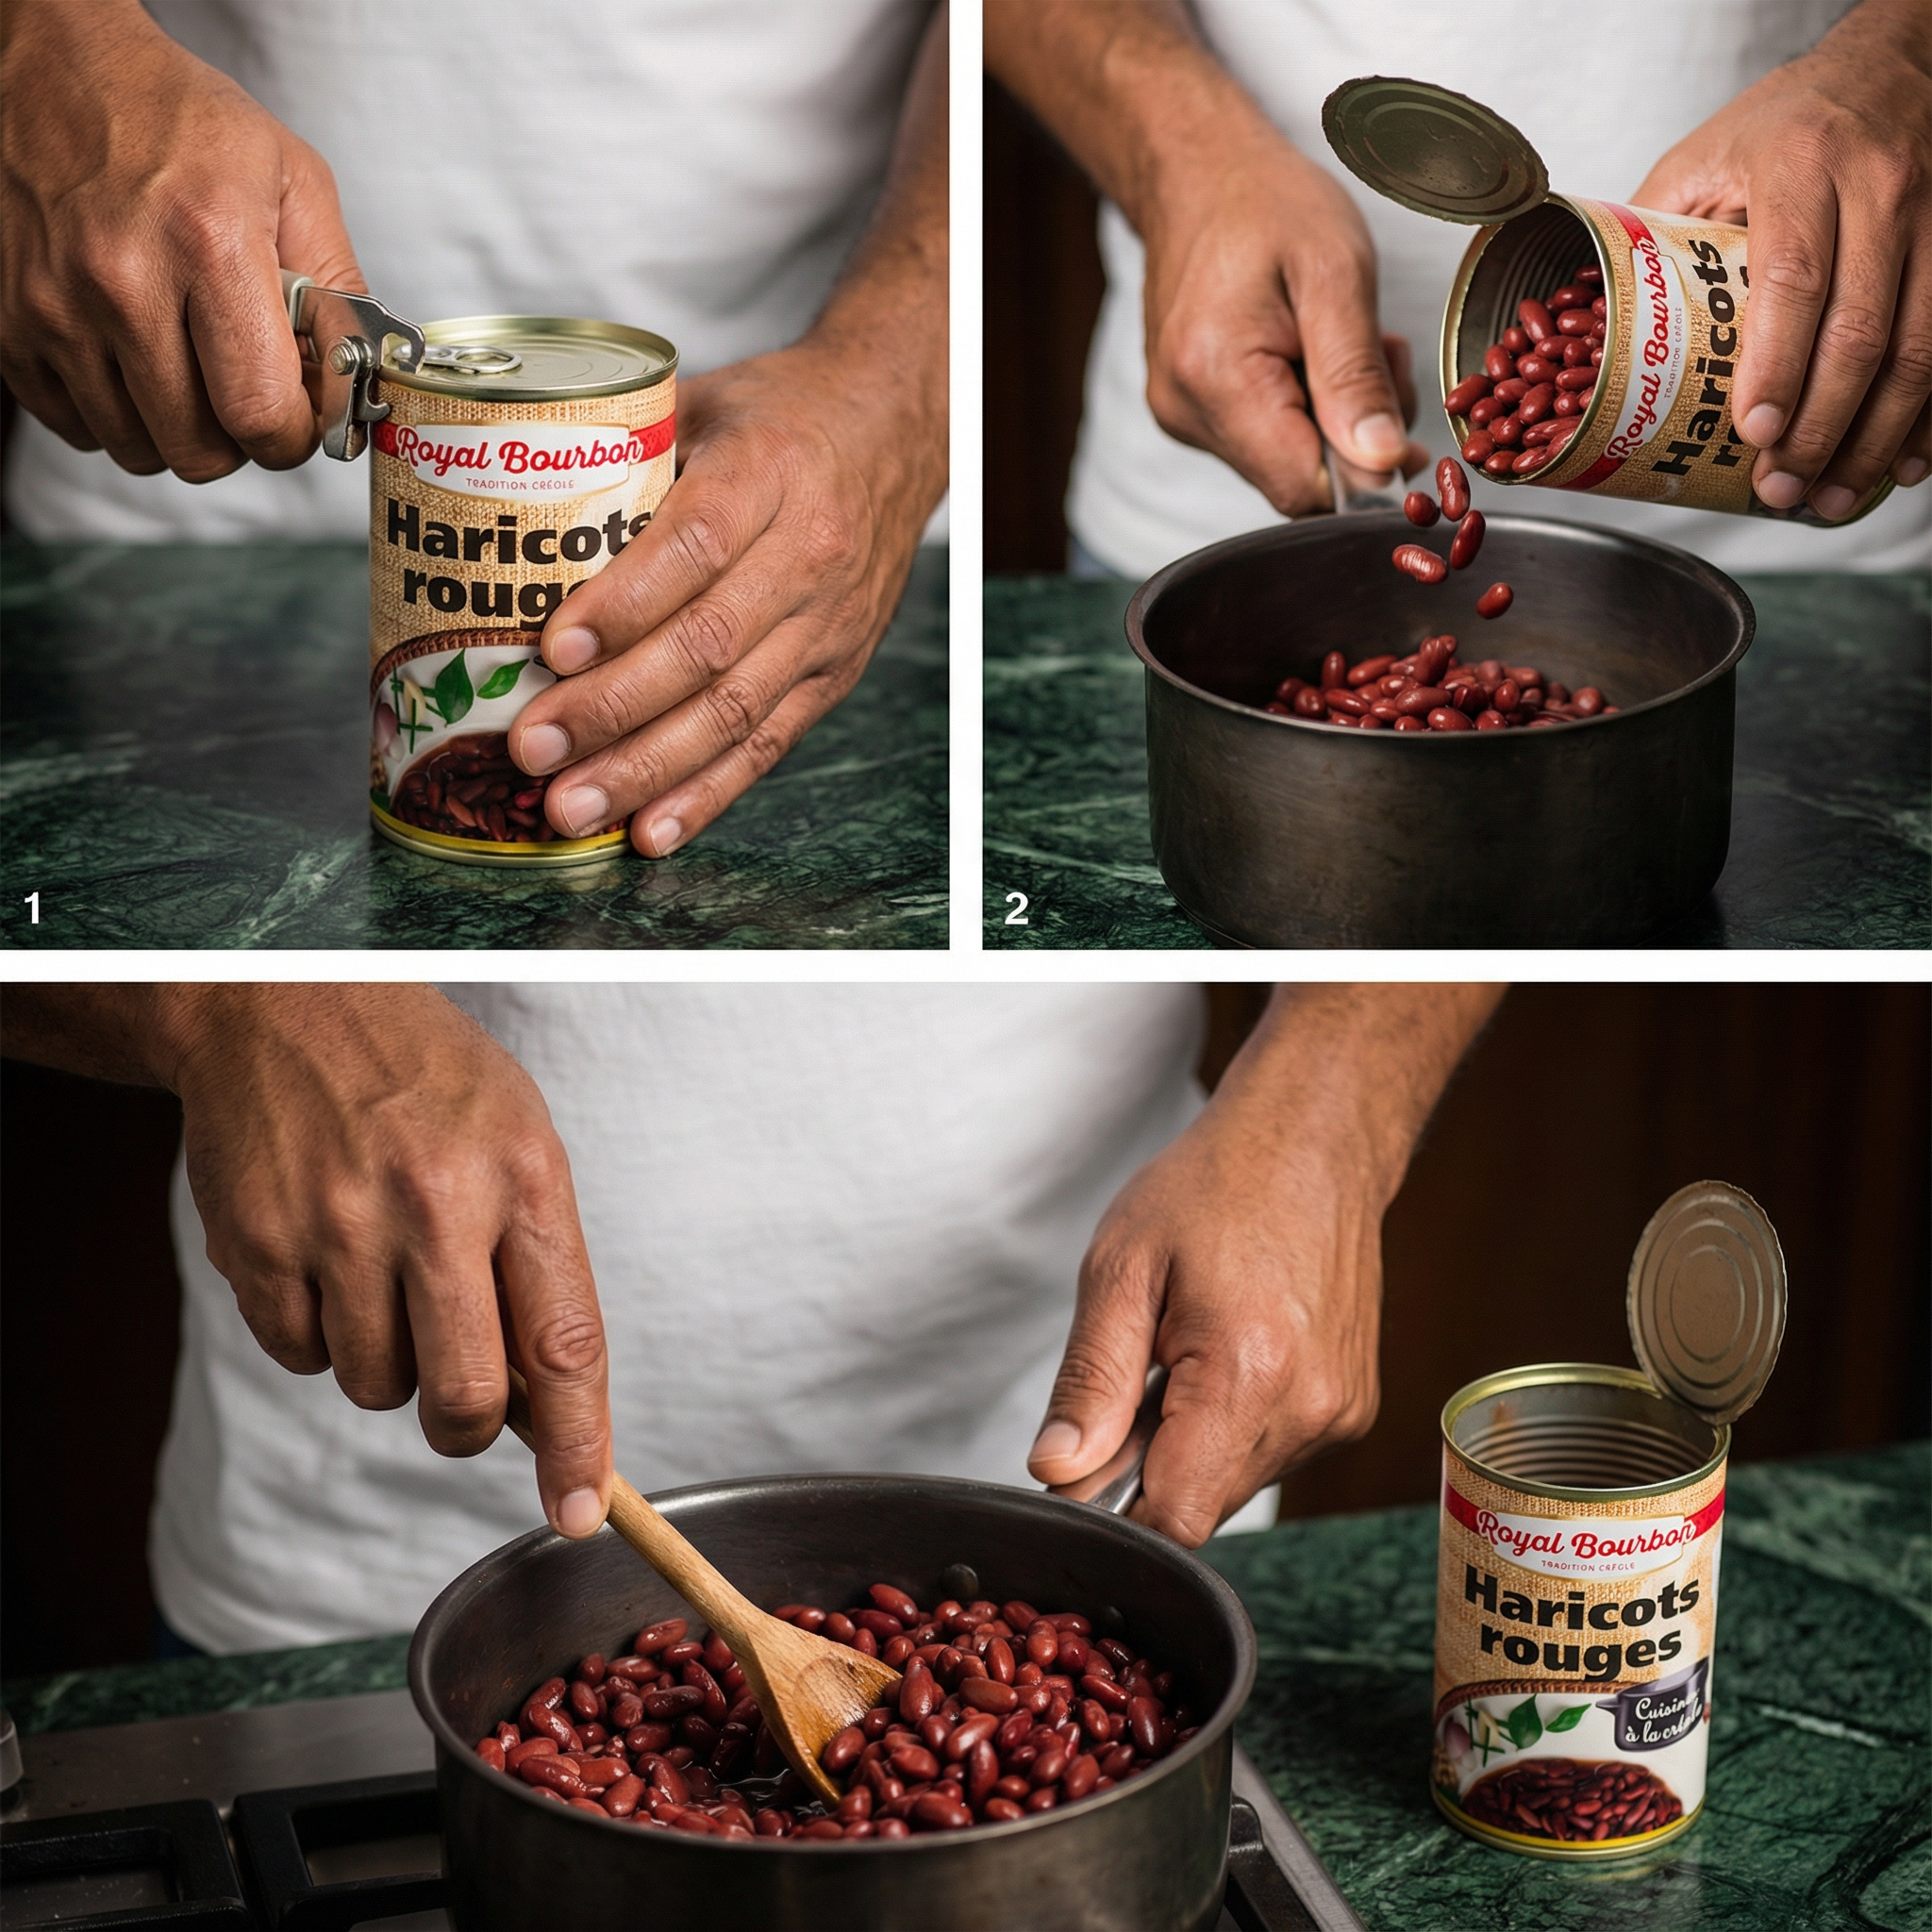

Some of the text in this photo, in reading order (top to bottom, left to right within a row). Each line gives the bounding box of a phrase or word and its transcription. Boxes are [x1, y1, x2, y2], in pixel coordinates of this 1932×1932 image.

[1607, 238, 1670, 458] Royal Bourbon
[1651, 240, 1737, 475] Haricots
[397, 426, 641, 476] Royal Bourbon
[465, 478, 526, 490] TRADITION
[403, 568, 590, 631] roug
[1478, 1510, 1694, 1558] Royal Bourbon
[1464, 1563, 1699, 1630] Haricots
[1480, 1623, 1682, 1682] rouges
[1635, 1688, 1700, 1720] Cuisin
[1625, 1725, 1640, 1742] à
[1642, 1721, 1661, 1743] la
